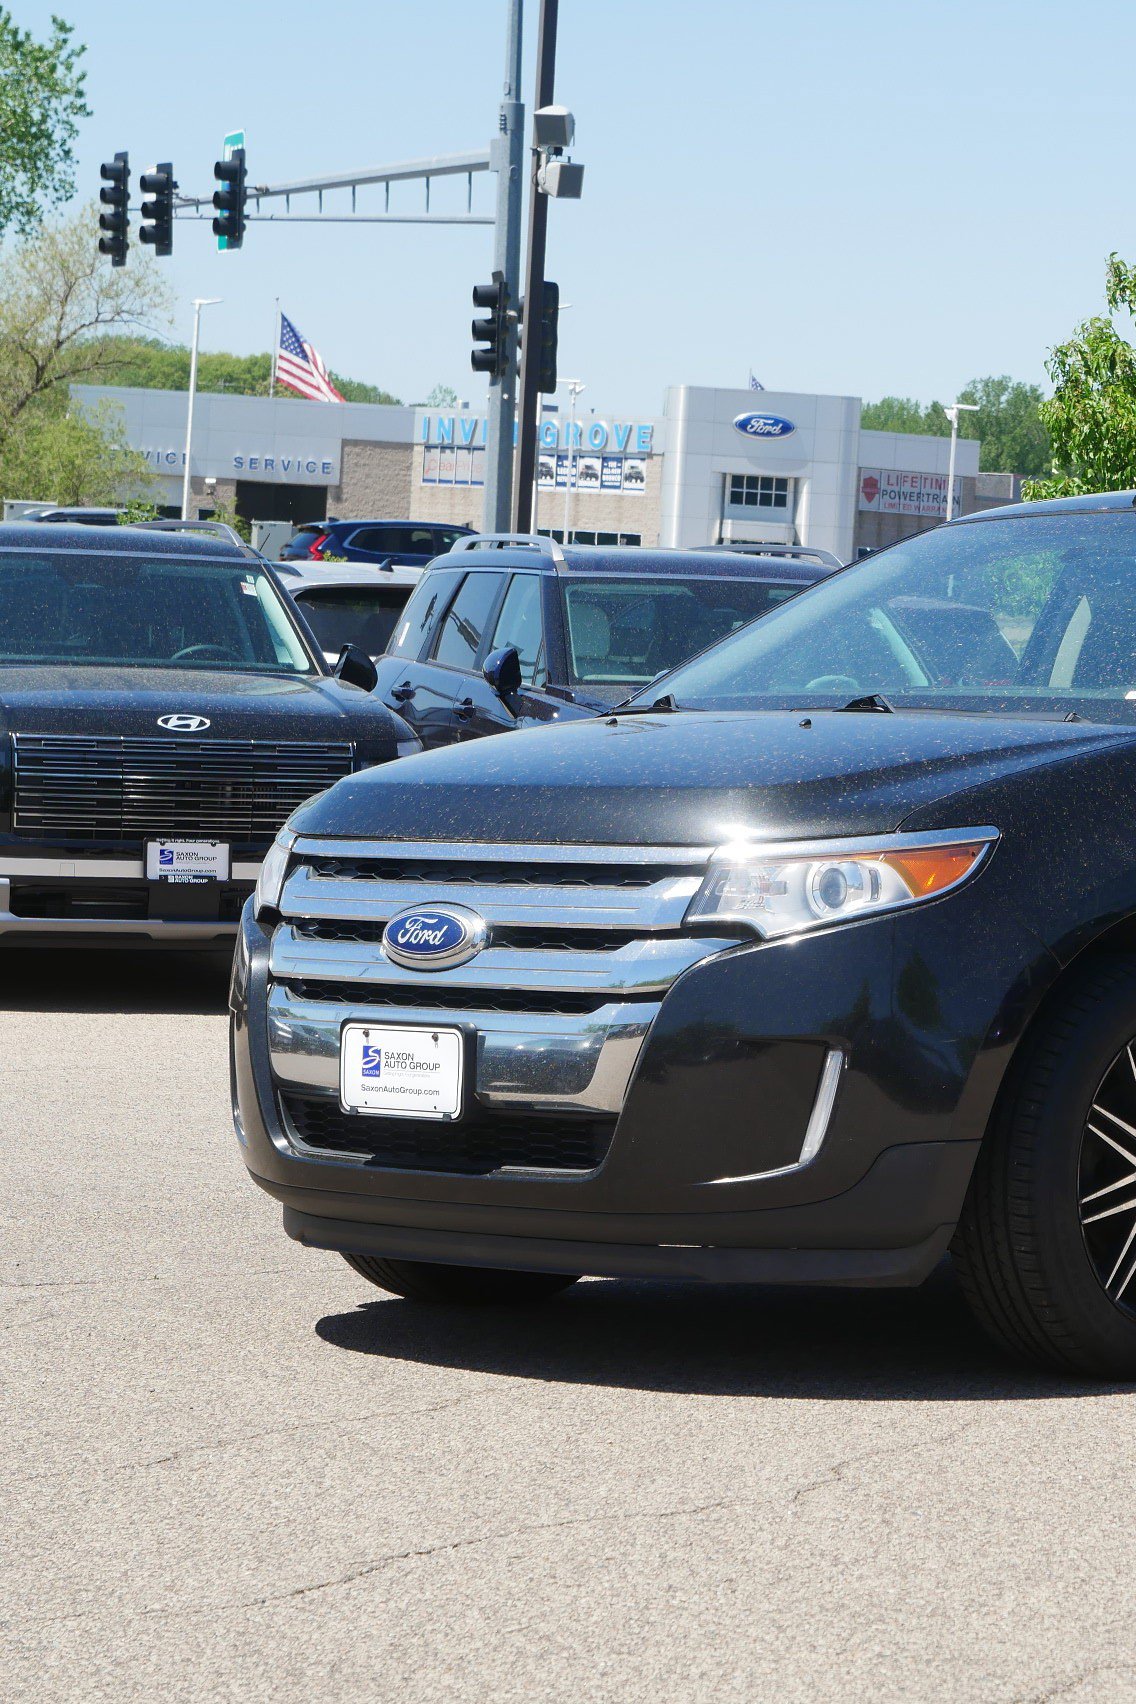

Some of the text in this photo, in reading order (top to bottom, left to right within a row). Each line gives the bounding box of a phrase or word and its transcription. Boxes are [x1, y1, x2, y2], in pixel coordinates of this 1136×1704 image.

[746, 417, 783, 435] Ford
[540, 420, 651, 452] GROVE
[233, 456, 332, 475] SERVICE
[881, 489, 960, 506] POWERTRAN
[397, 916, 448, 946] Ford
[384, 1051, 414, 1061] SAXON
[384, 1060, 441, 1071] AUTO GROUP
[361, 1083, 440, 1096] SaxonAutoGroup.com
